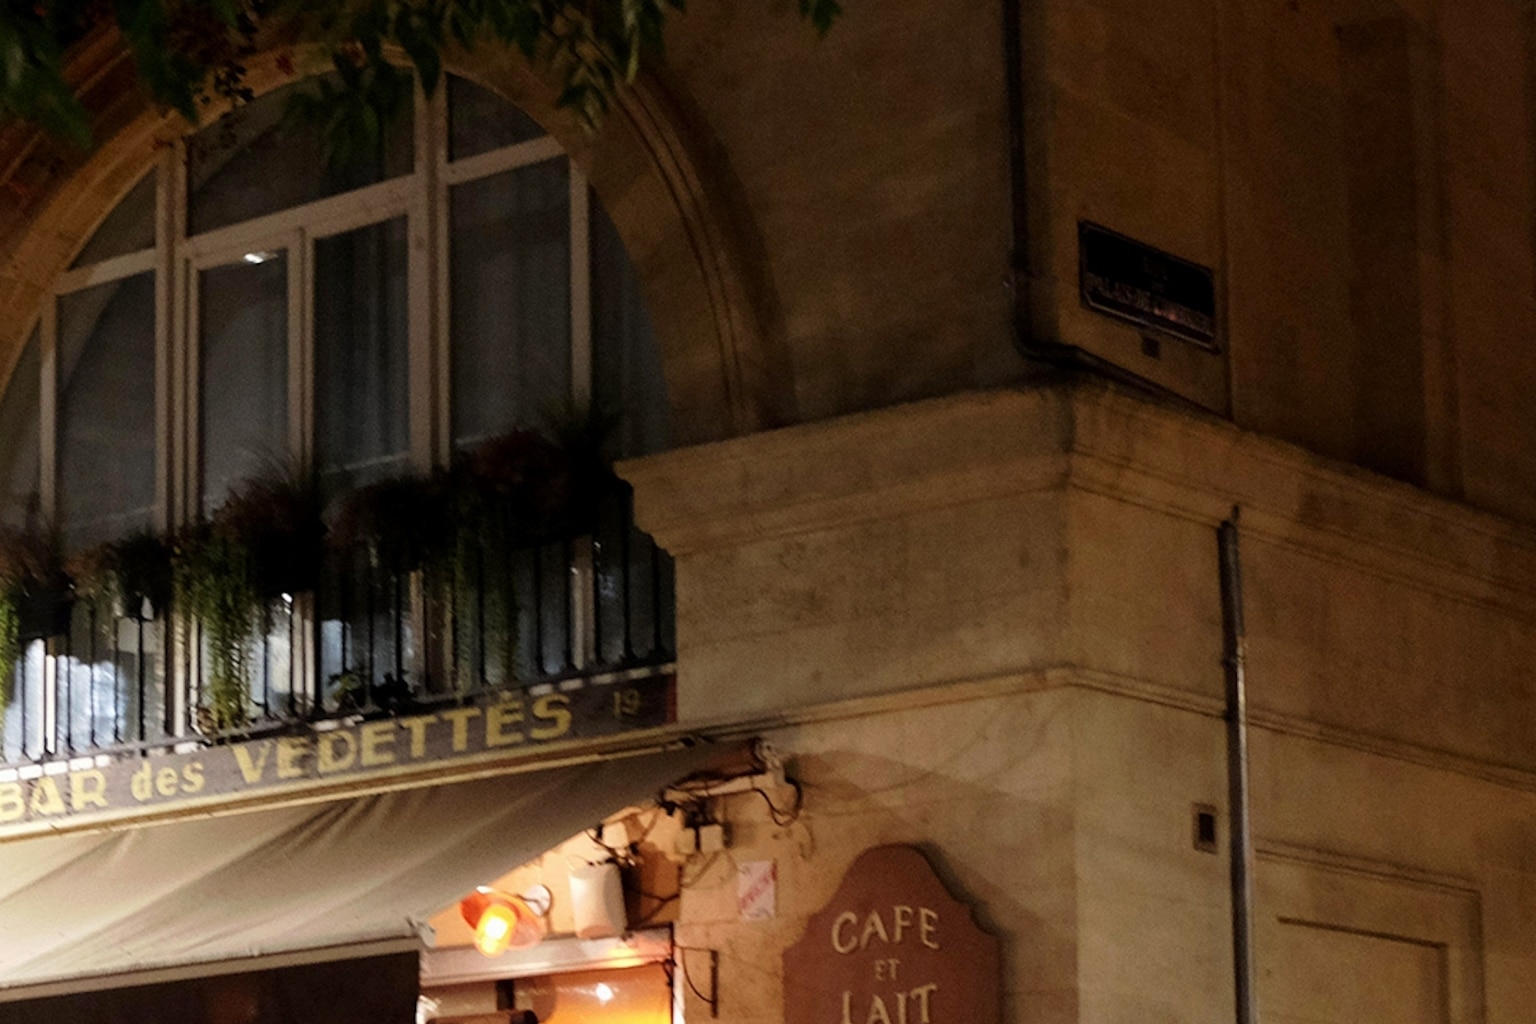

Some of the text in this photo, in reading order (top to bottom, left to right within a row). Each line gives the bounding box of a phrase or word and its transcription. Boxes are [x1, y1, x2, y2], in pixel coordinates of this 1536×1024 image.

[130, 760, 206, 802] des
[614, 688, 640, 719] 19
[831, 905, 941, 953] CAFE
[875, 959, 900, 982] ET
